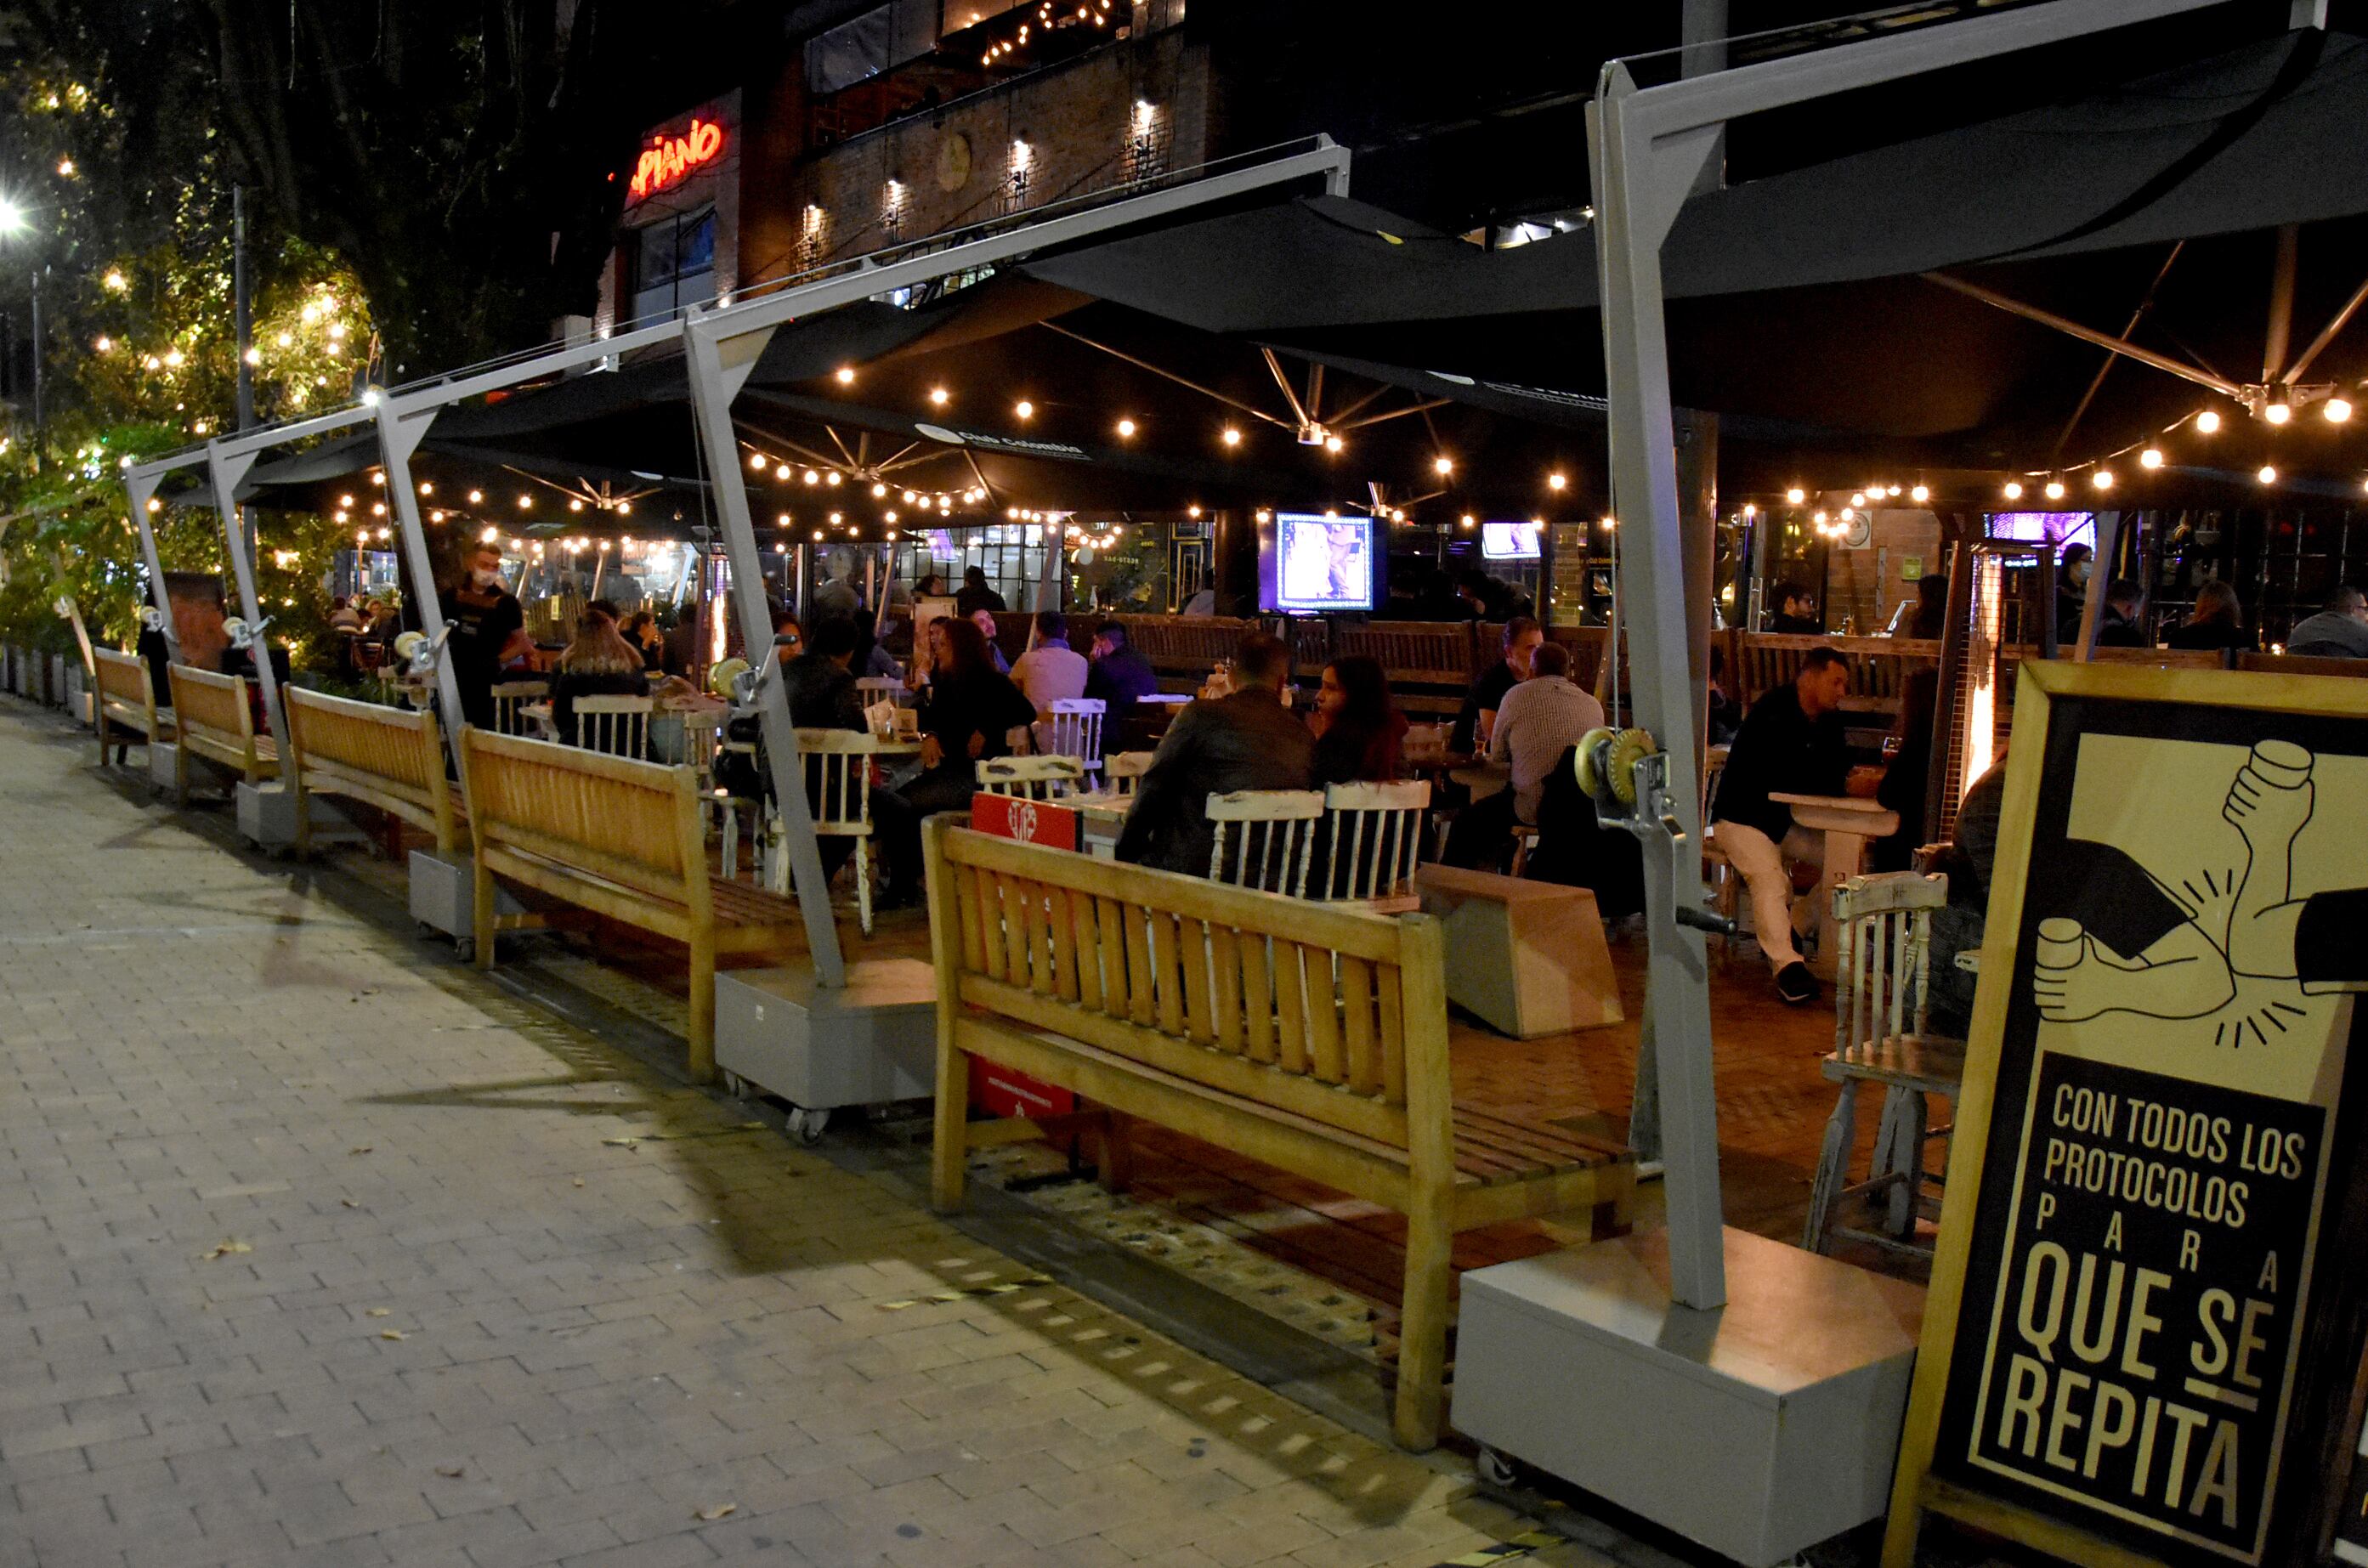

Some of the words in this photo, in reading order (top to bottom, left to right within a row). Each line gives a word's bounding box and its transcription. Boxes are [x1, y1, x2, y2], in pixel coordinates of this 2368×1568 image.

[631, 119, 722, 196] PIANO
[2052, 1083, 2117, 1137] CON
[2127, 1097, 2231, 1163] TODOS
[2240, 1123, 2306, 1180] LOS
[2043, 1137, 2249, 1229] PROTOCOLOS
[2017, 1241, 2173, 1381] QUE
[2190, 1288, 2275, 1390] SE
[1997, 1353, 2239, 1530] REPITA
